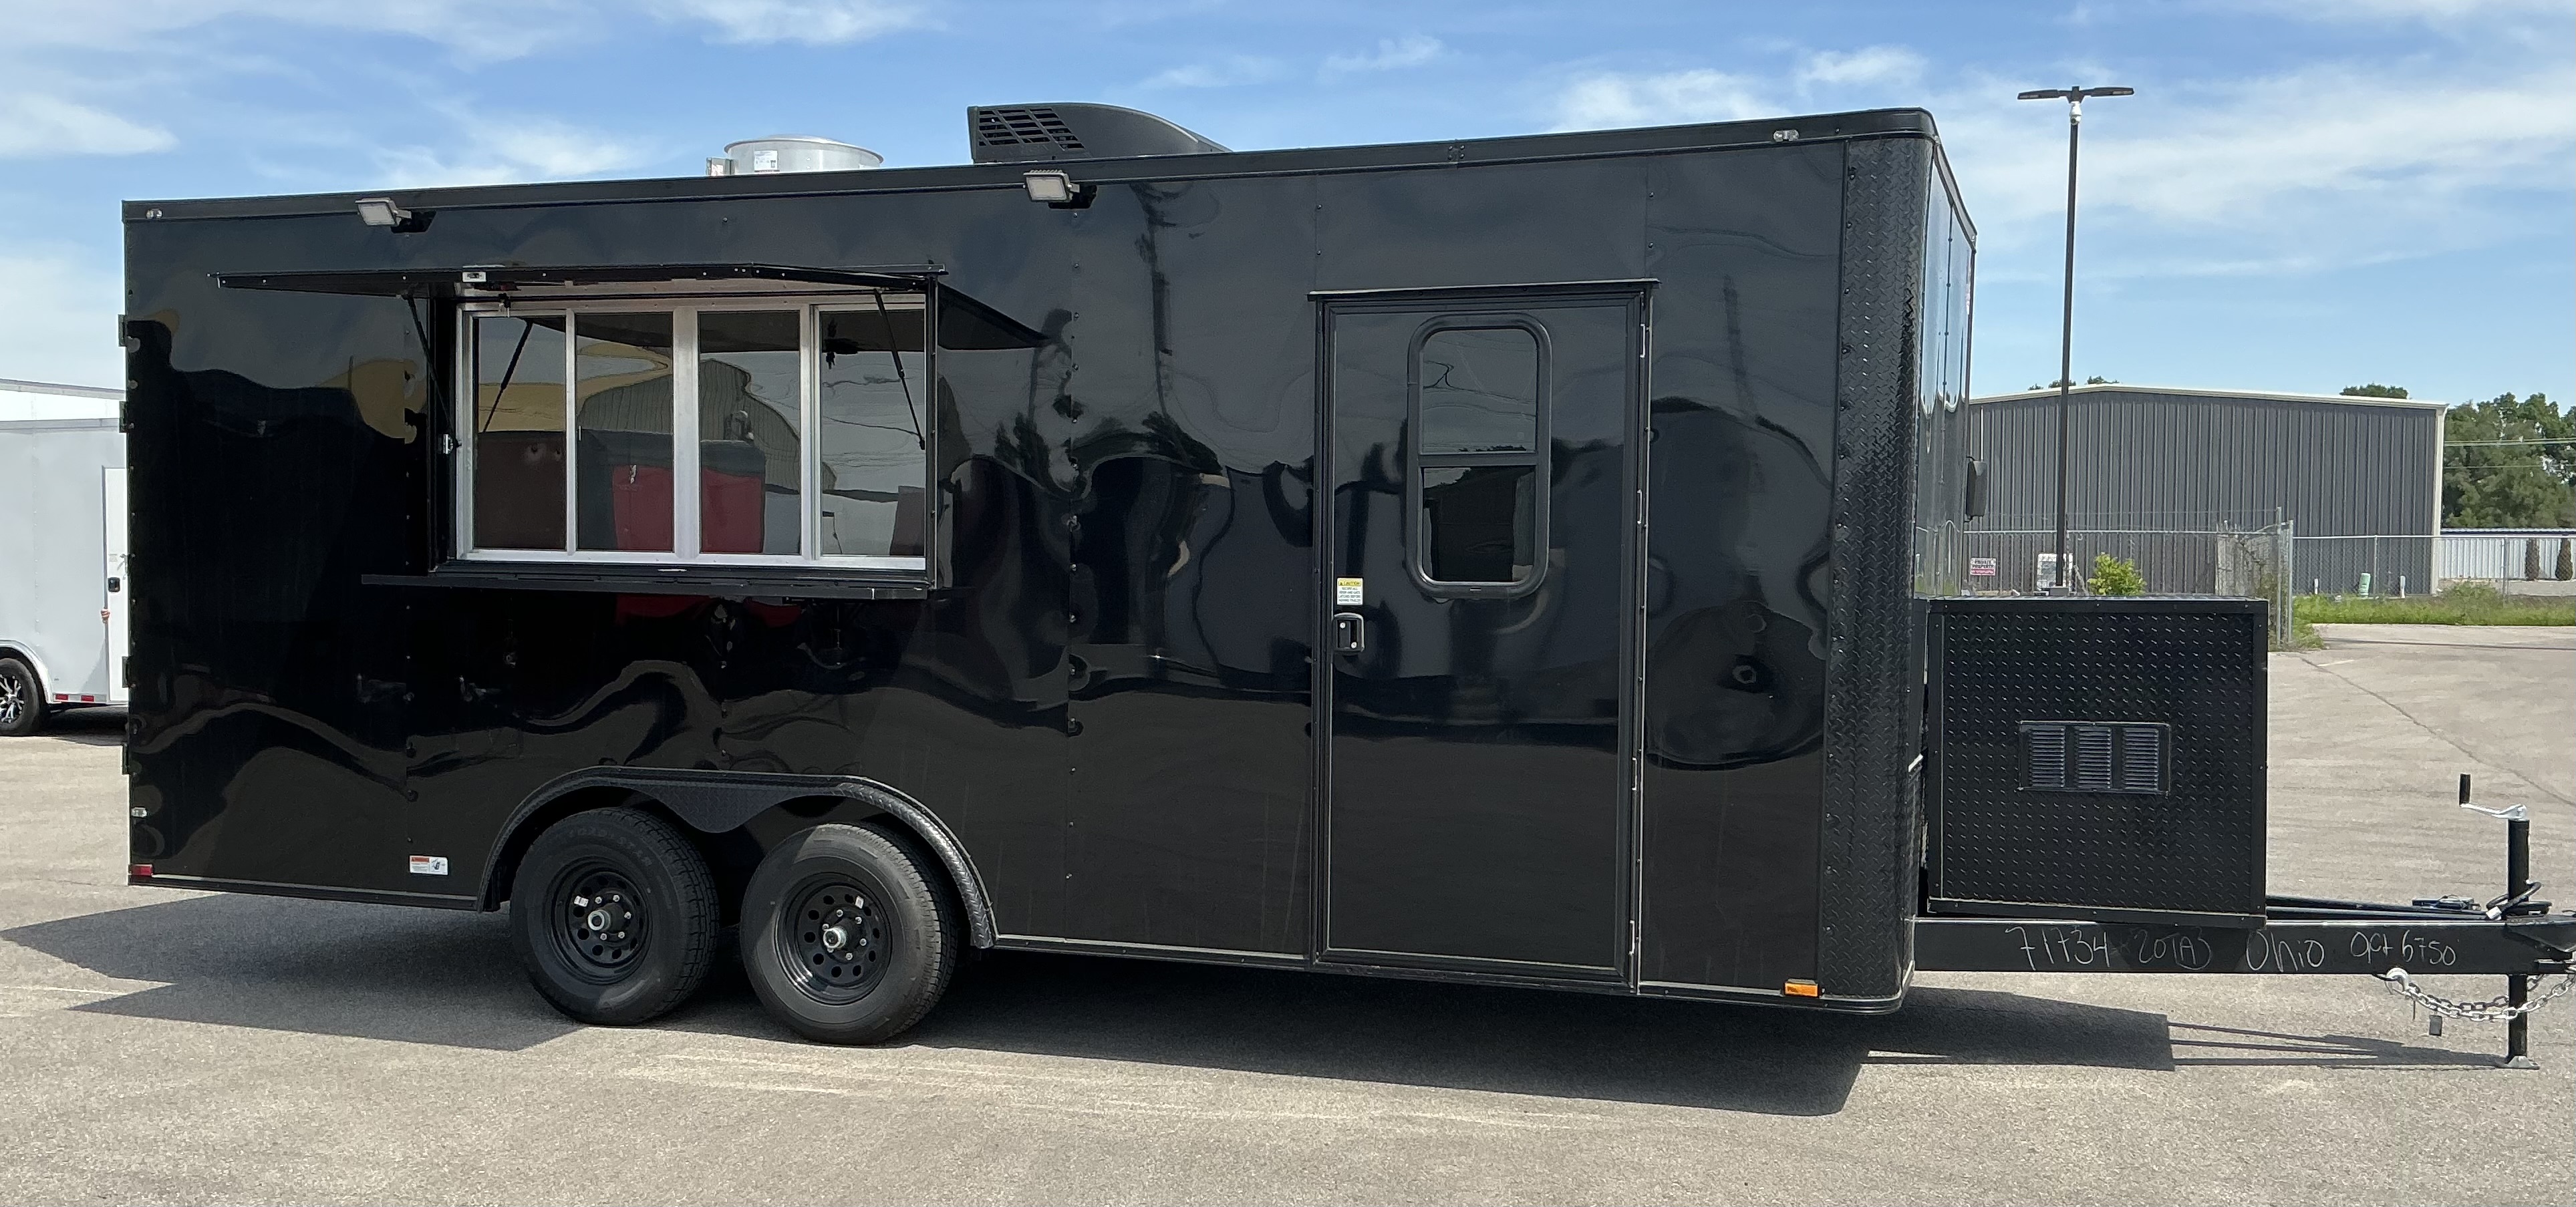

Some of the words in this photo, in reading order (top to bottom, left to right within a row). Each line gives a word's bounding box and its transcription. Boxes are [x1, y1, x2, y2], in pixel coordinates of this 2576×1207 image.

[2005, 926, 2110, 971] 71734
[2246, 930, 2325, 973] Ohio
[2402, 929, 2457, 967] 6750
